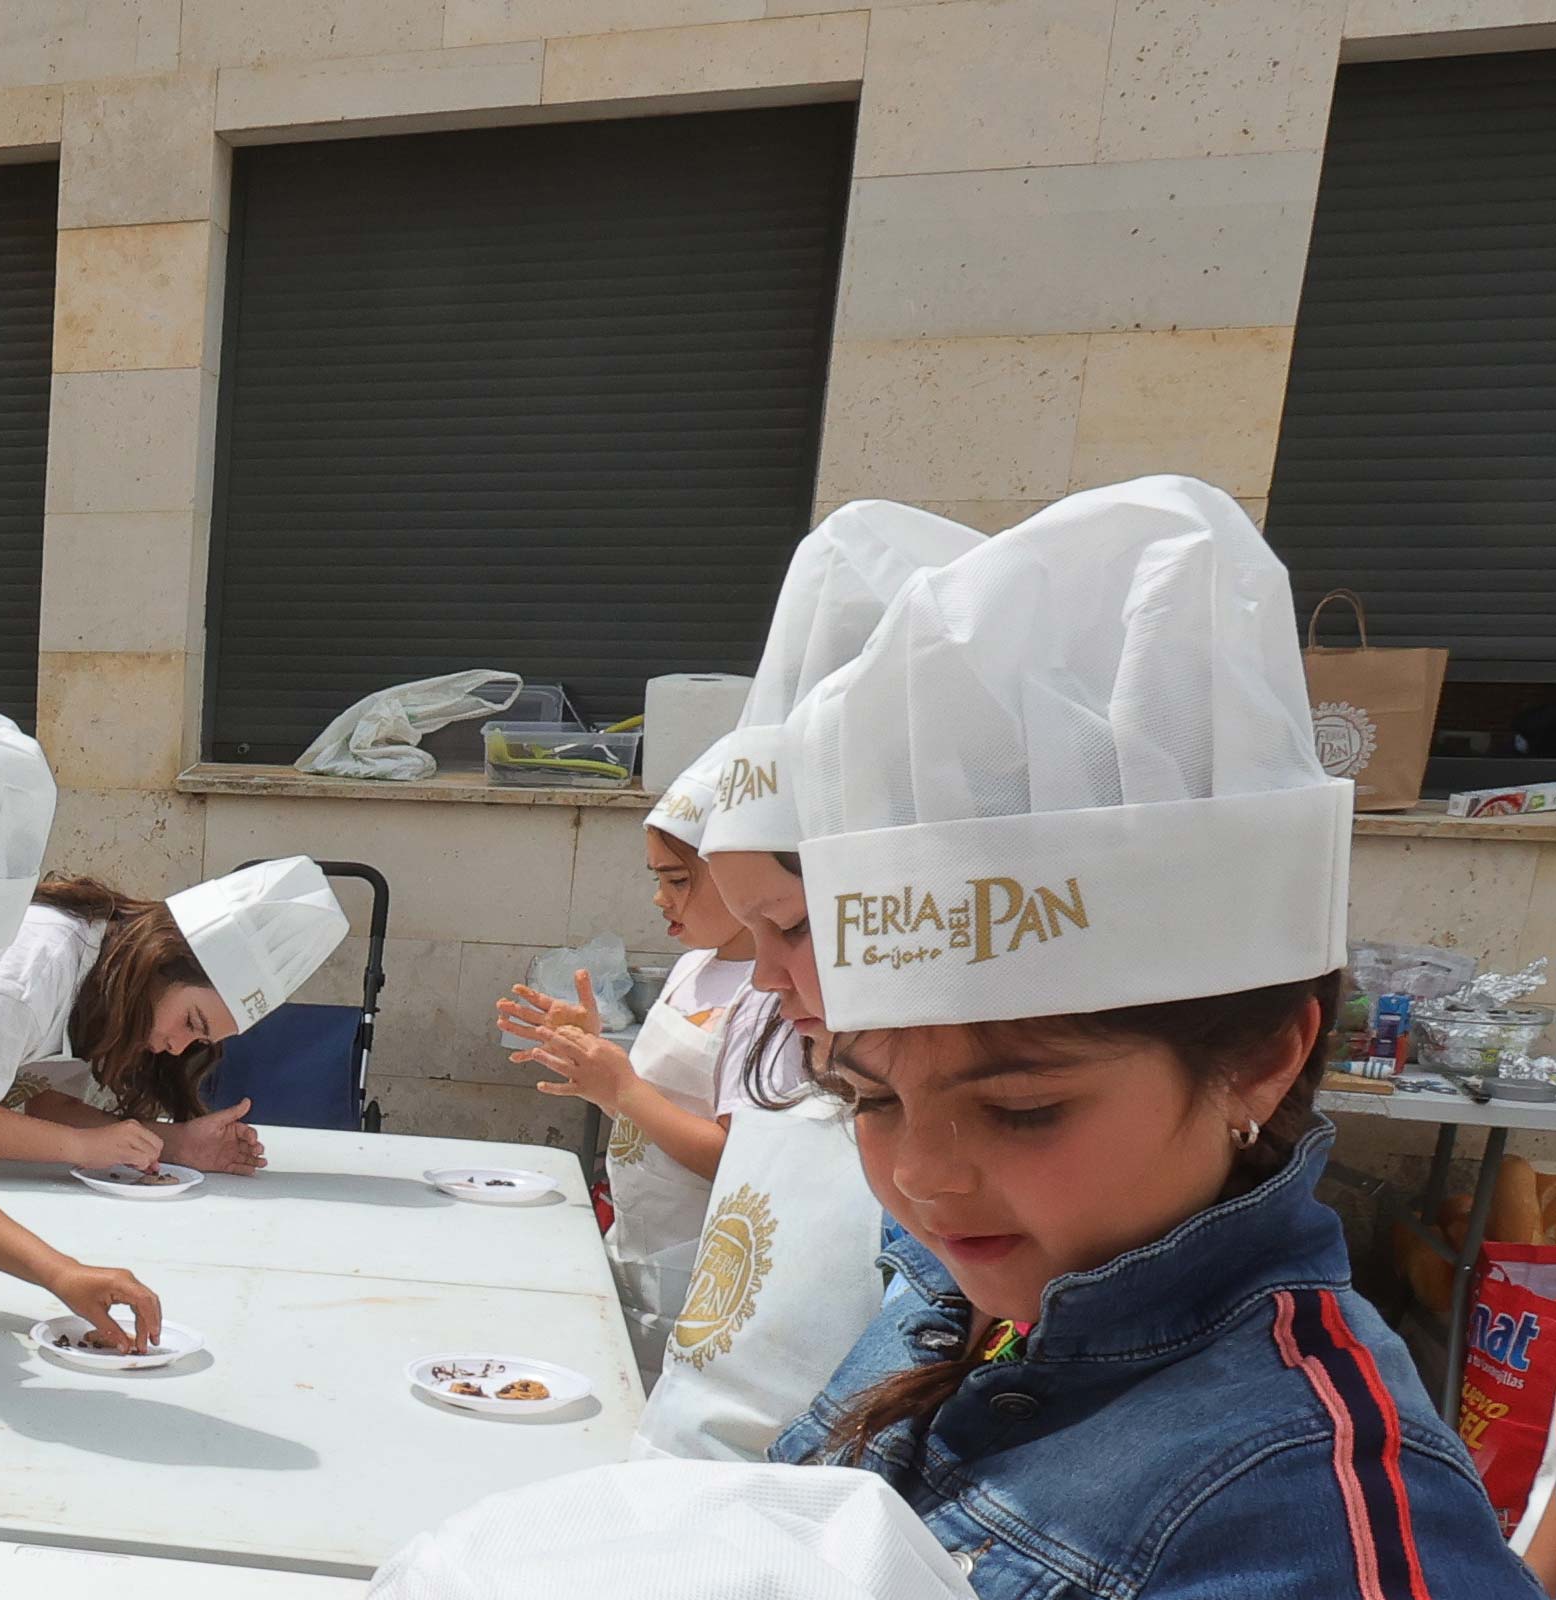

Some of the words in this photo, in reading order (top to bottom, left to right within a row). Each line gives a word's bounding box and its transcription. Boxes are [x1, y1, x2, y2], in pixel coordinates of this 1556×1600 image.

[722, 758, 778, 813] PAN
[833, 885, 948, 968] FERIA
[948, 899, 971, 949] DEL
[966, 873, 1090, 966] PAN
[705, 1240, 740, 1282] FERIA
[681, 1269, 732, 1317] PAN
